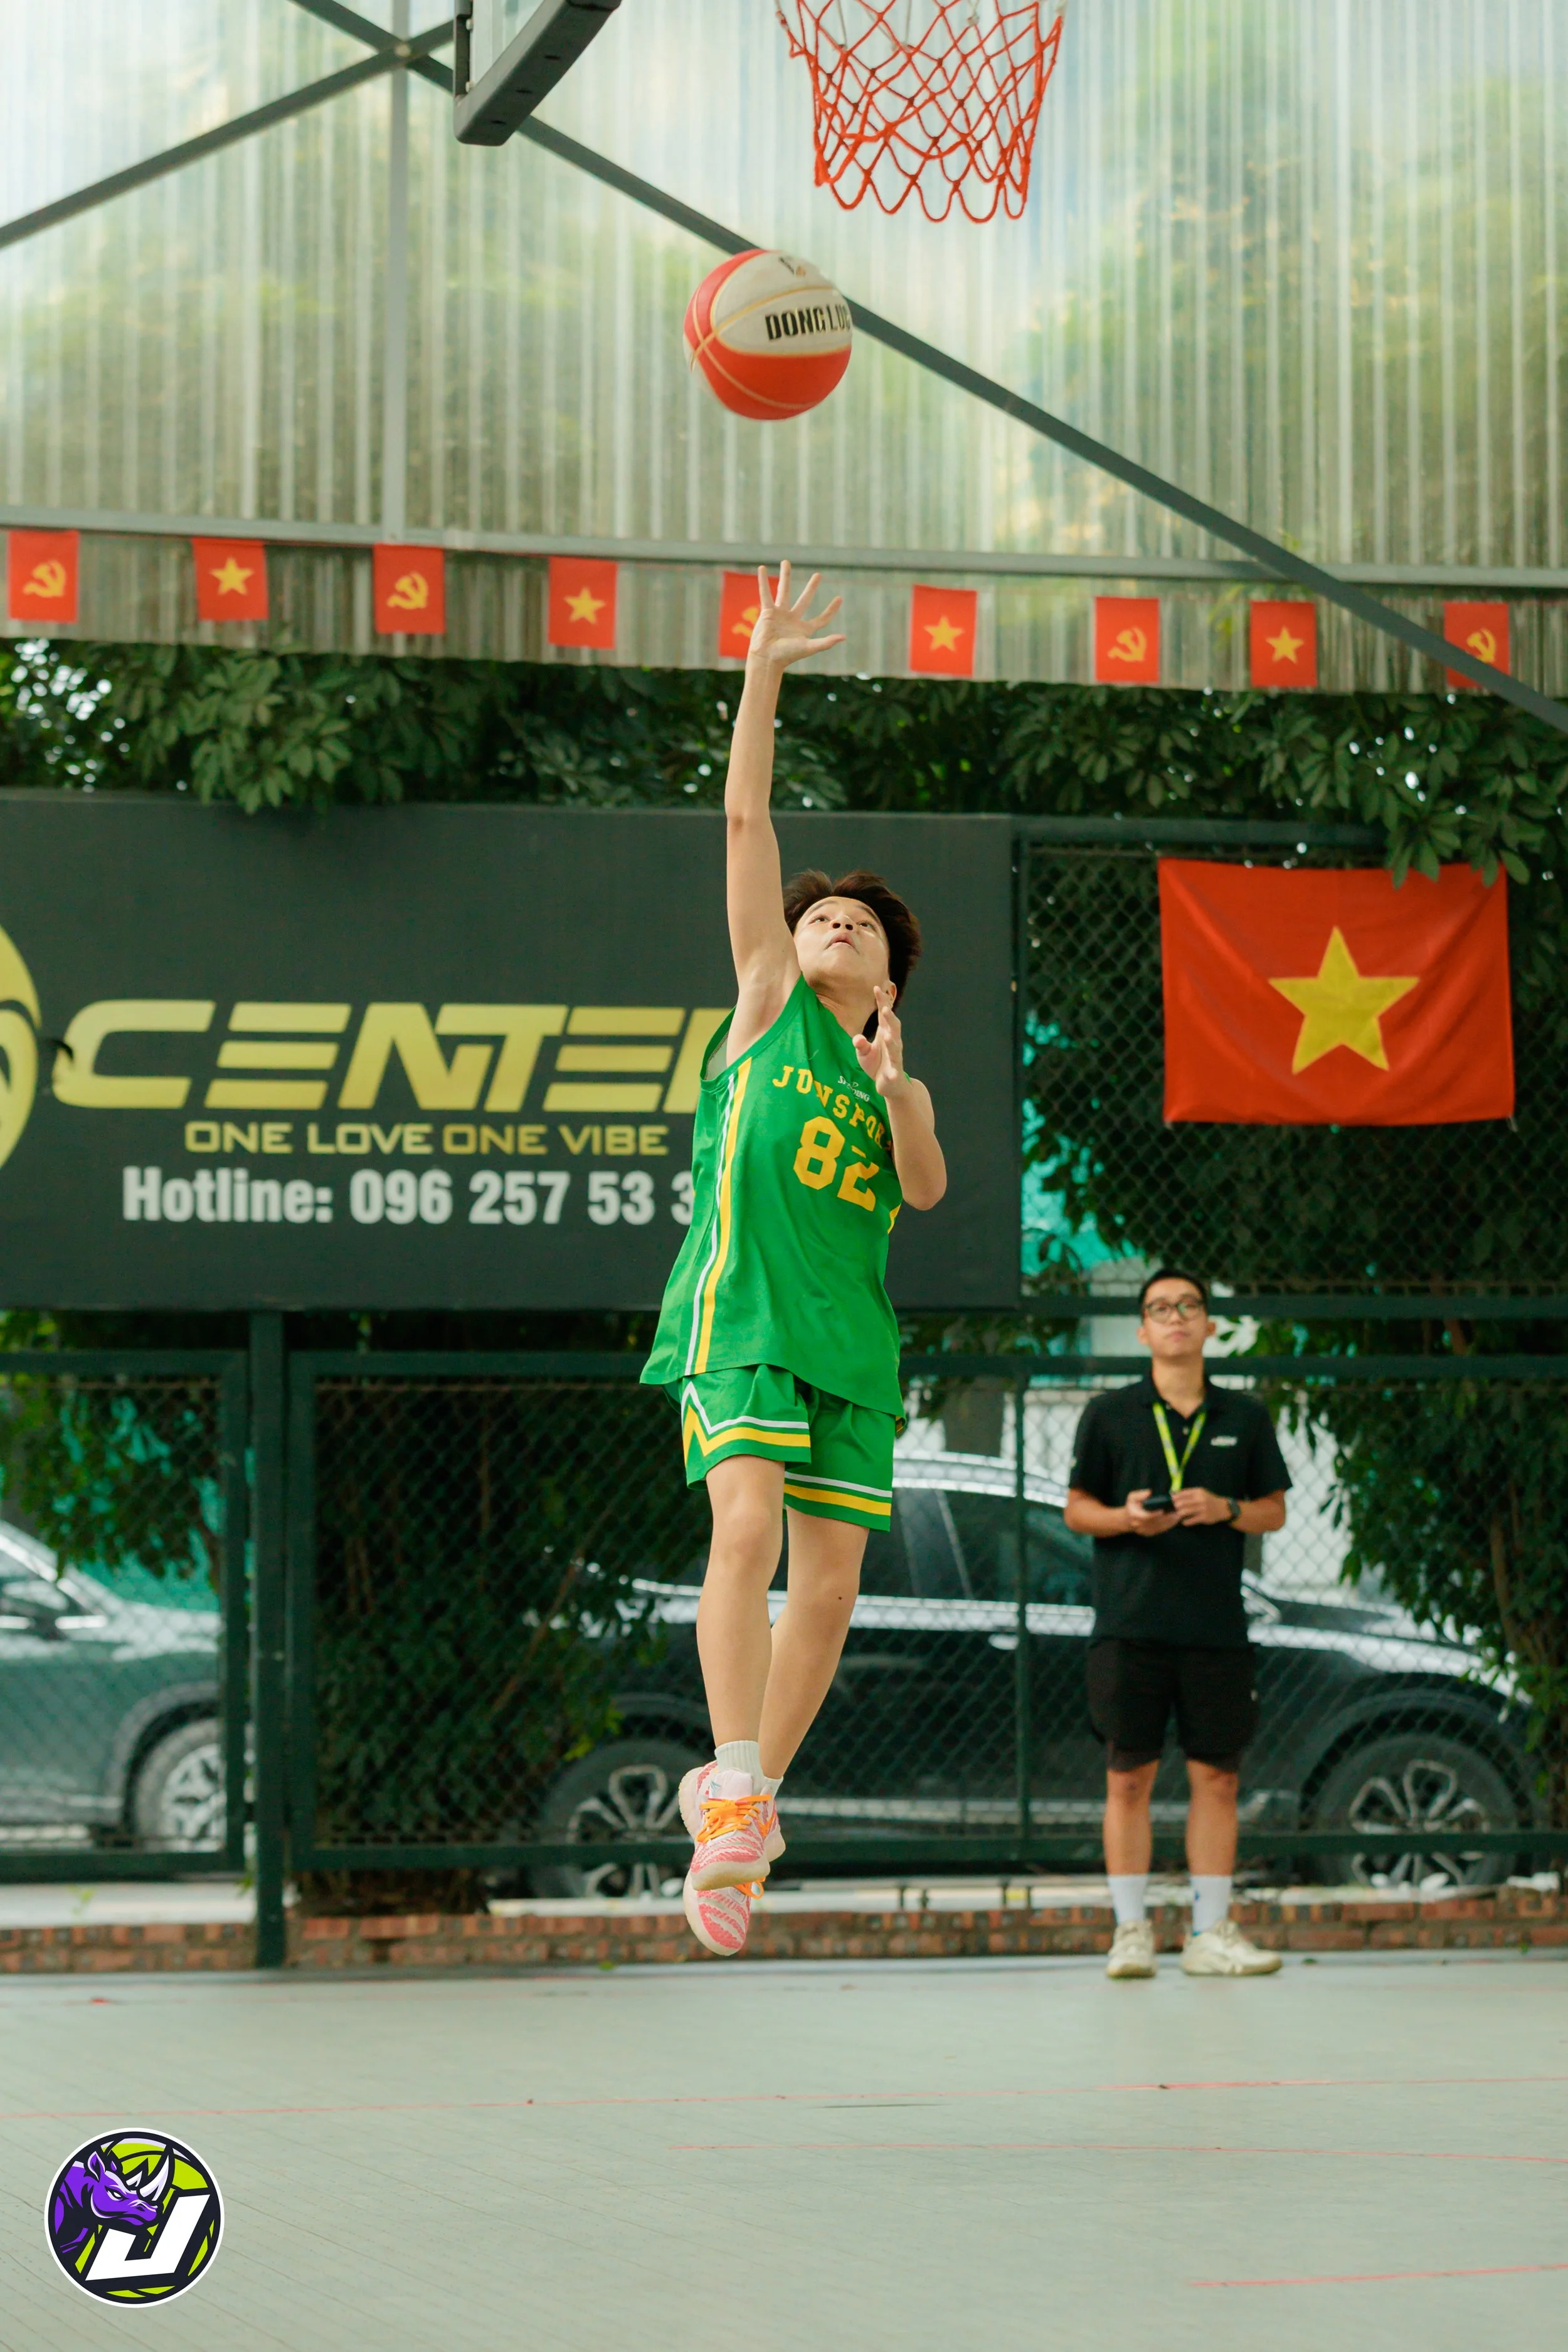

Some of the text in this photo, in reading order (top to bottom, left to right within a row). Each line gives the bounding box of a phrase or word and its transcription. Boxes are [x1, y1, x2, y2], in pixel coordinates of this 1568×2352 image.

[184, 1121, 669, 1156] ONE LOVE ONE VIBE
[793, 1116, 879, 1212] 82
[123, 1165, 333, 1223] Hotline:
[349, 1168, 453, 1225] 096
[469, 1169, 570, 1226] 257
[588, 1170, 655, 1226] 53
